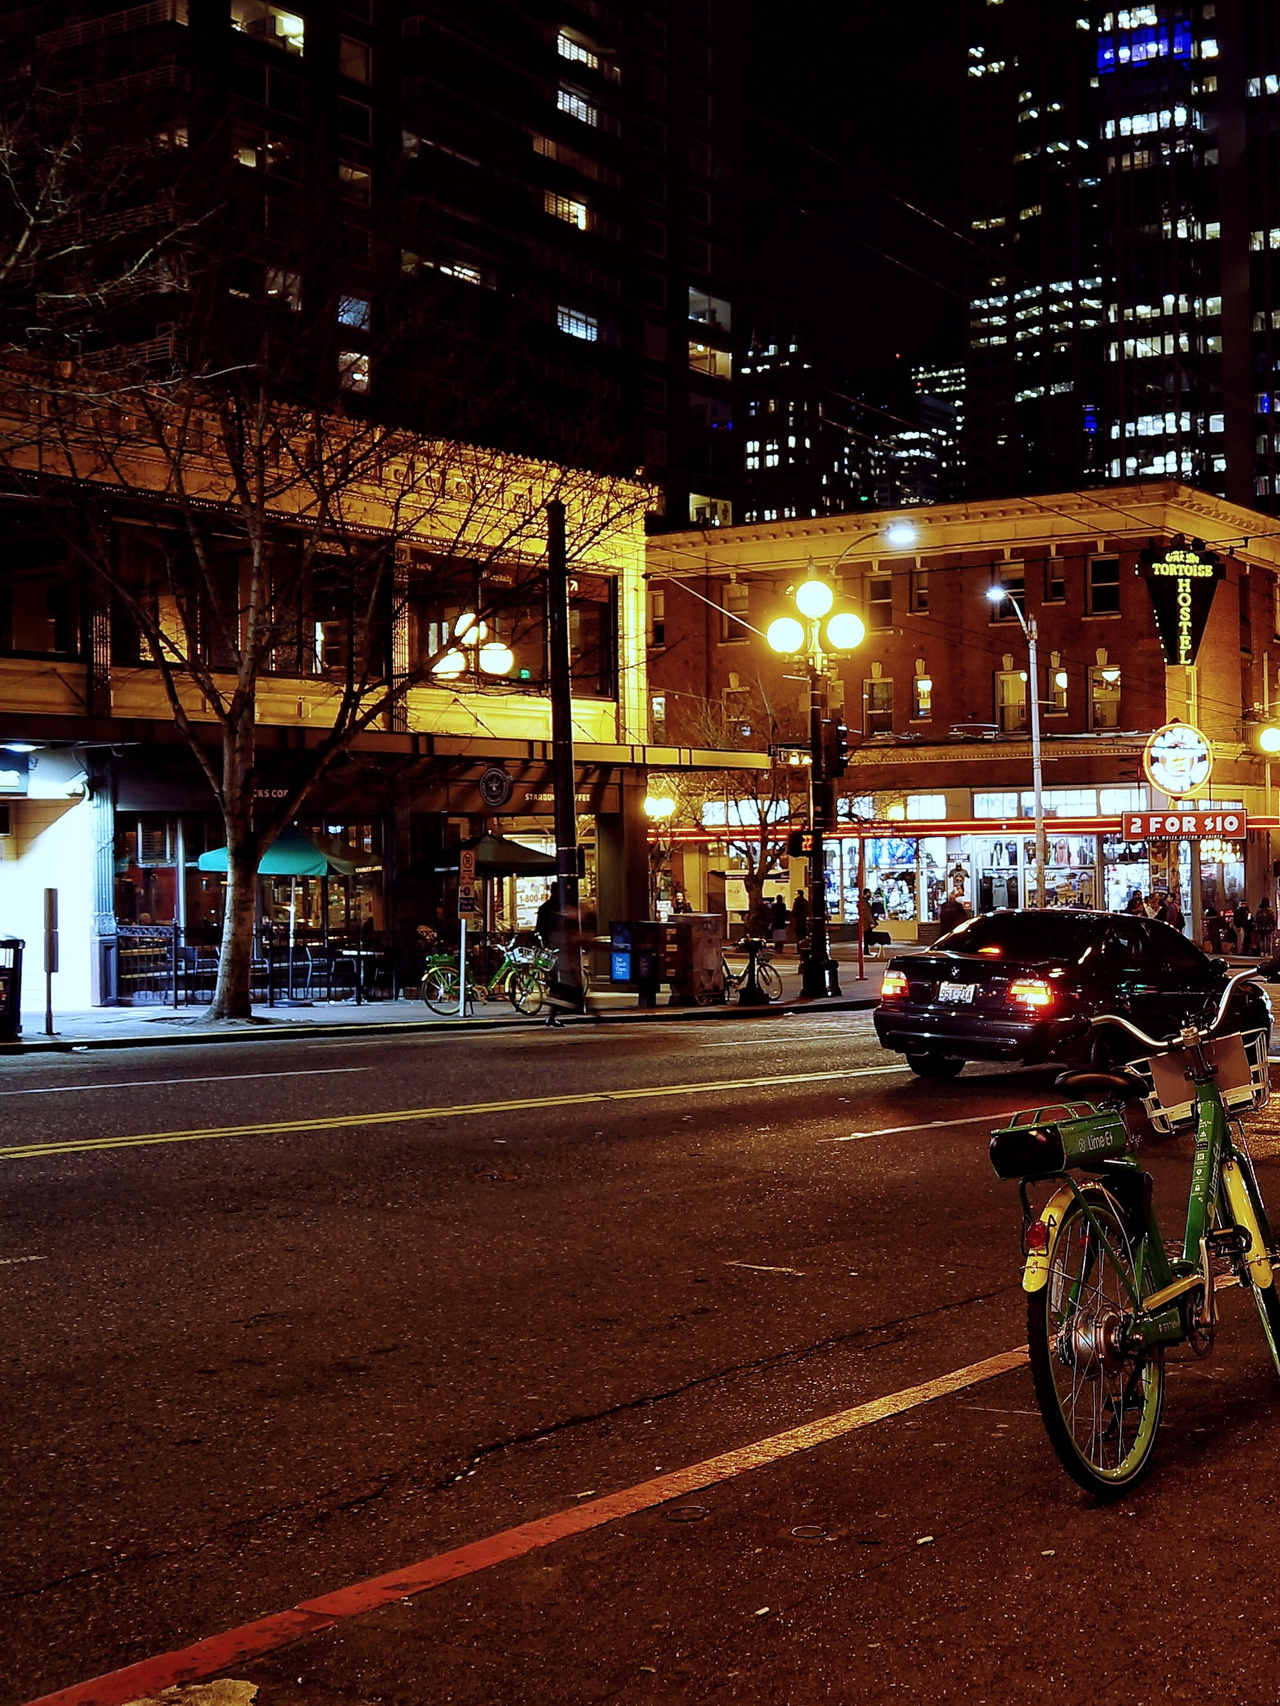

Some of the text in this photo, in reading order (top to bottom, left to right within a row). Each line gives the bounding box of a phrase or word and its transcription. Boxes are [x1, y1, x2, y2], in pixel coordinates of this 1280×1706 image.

[1152, 562, 1214, 577] TORTOISE
[1177, 578, 1192, 665] HOSTEL
[1130, 814, 1239, 834] 2 FOR $10
